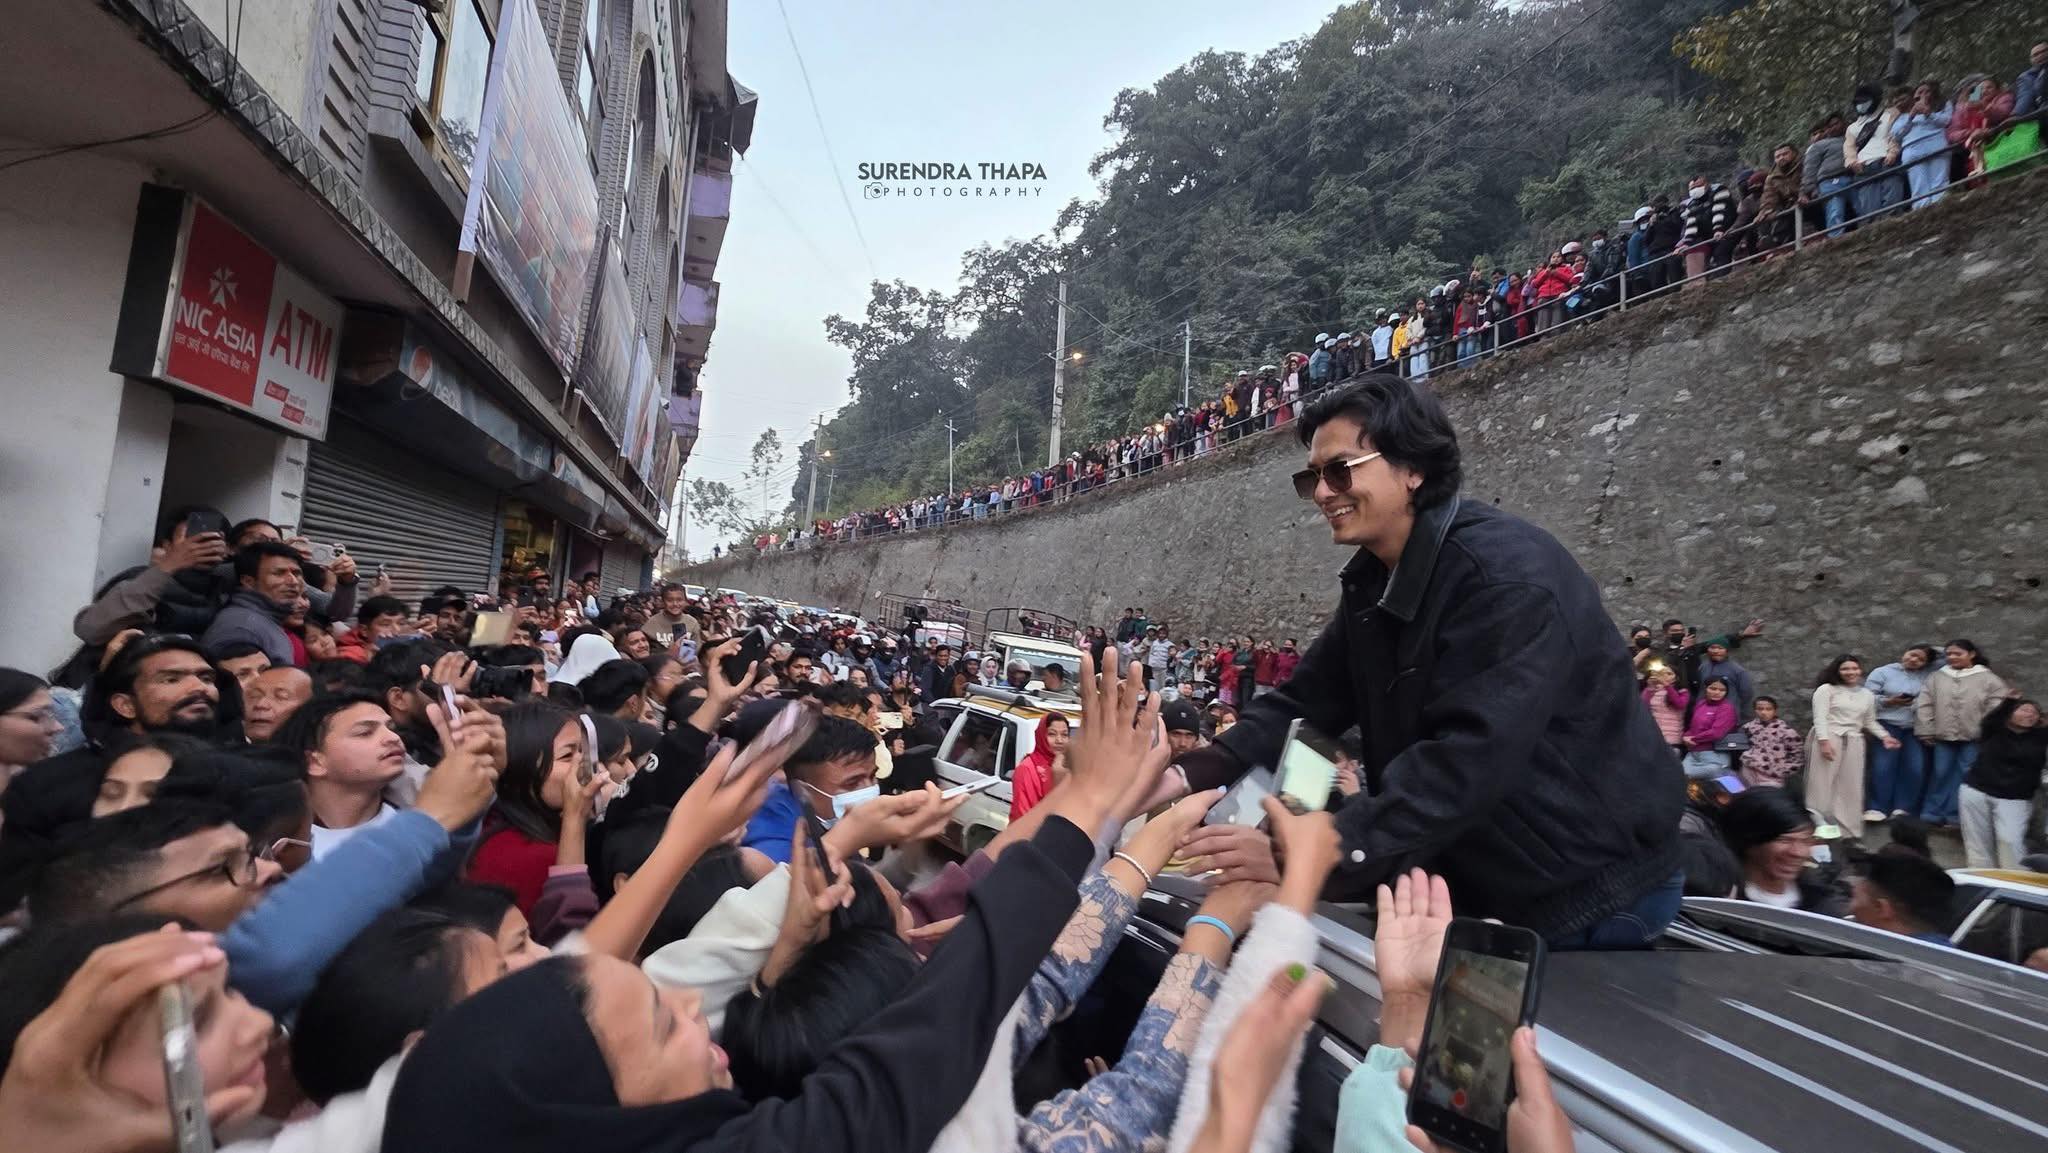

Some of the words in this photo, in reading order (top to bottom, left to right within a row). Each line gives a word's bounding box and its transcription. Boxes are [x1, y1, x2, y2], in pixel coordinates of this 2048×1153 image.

[176, 296, 213, 336] NIC
[214, 316, 257, 359] ASIA
[269, 300, 333, 383] ATM
